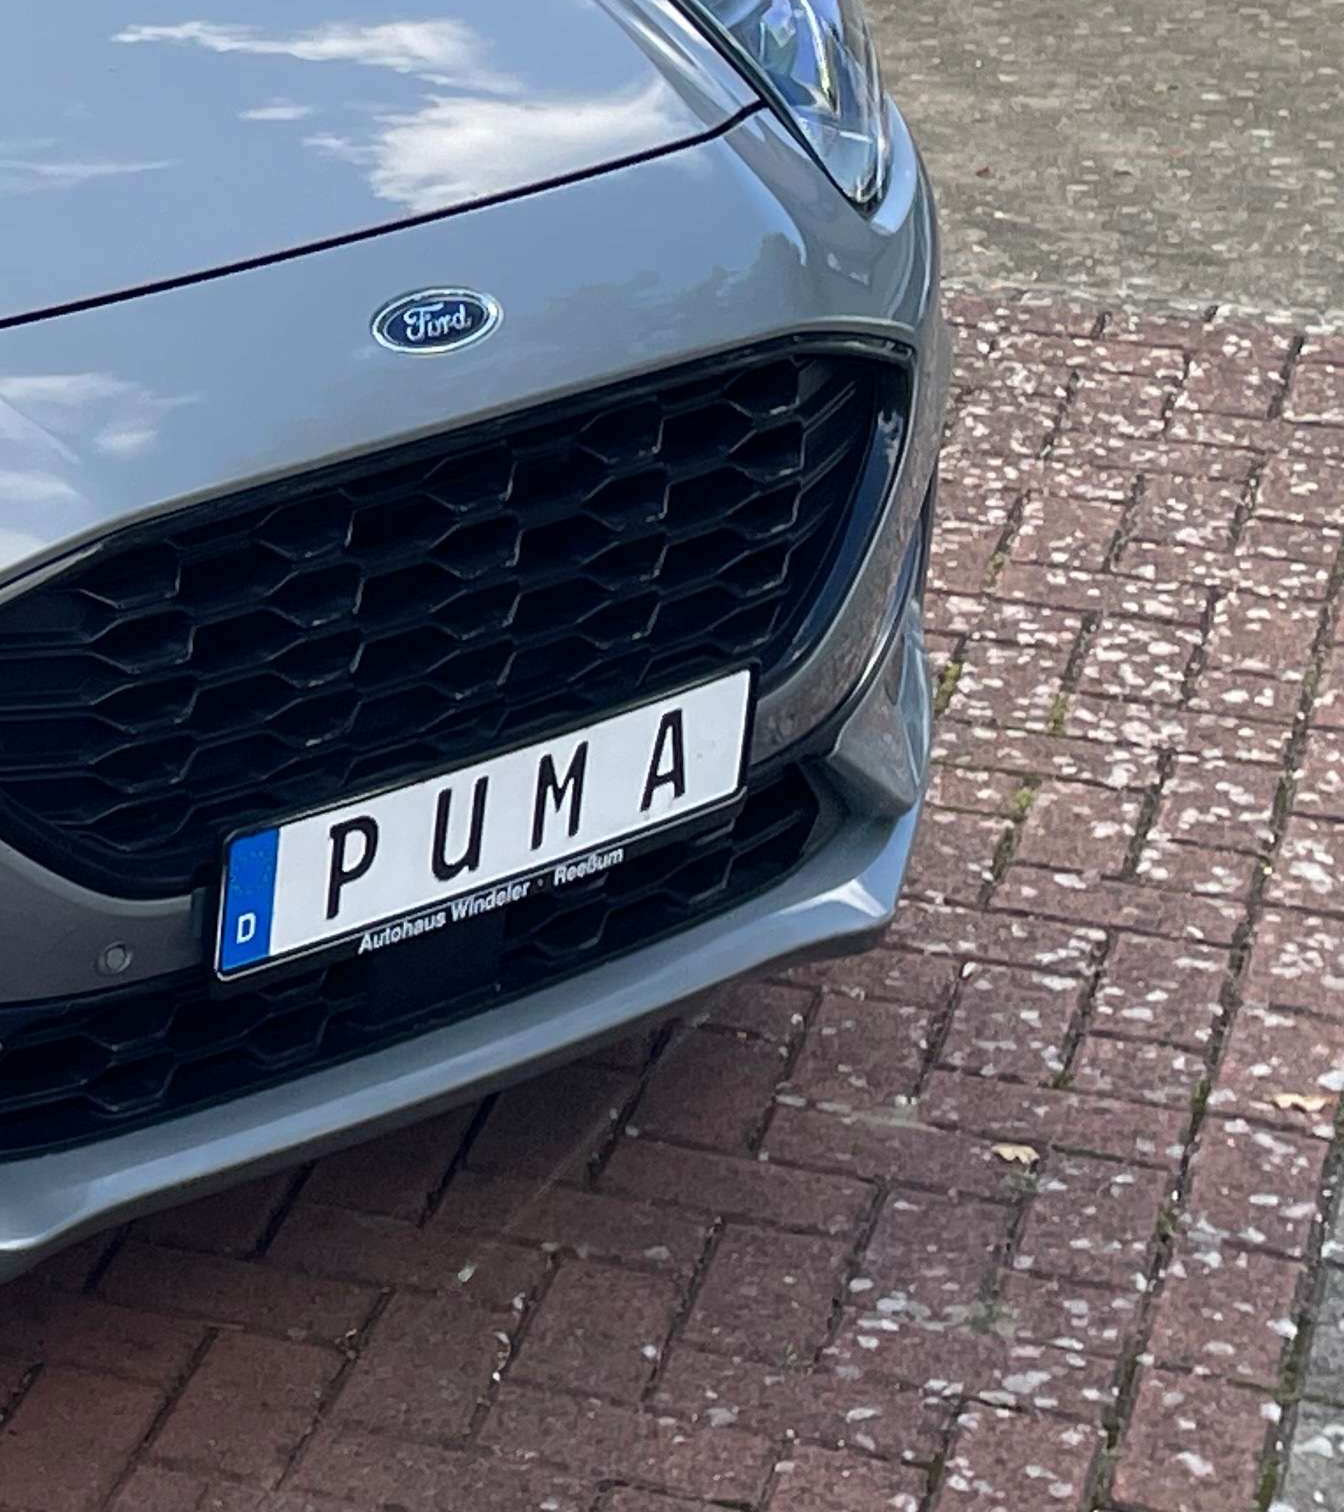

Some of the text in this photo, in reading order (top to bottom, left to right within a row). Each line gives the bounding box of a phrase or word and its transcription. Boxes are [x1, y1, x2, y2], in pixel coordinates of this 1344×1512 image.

[403, 302, 472, 342] Ford
[237, 912, 256, 945] D
[357, 912, 446, 955] Autohaus
[450, 880, 531, 923] Windeler
